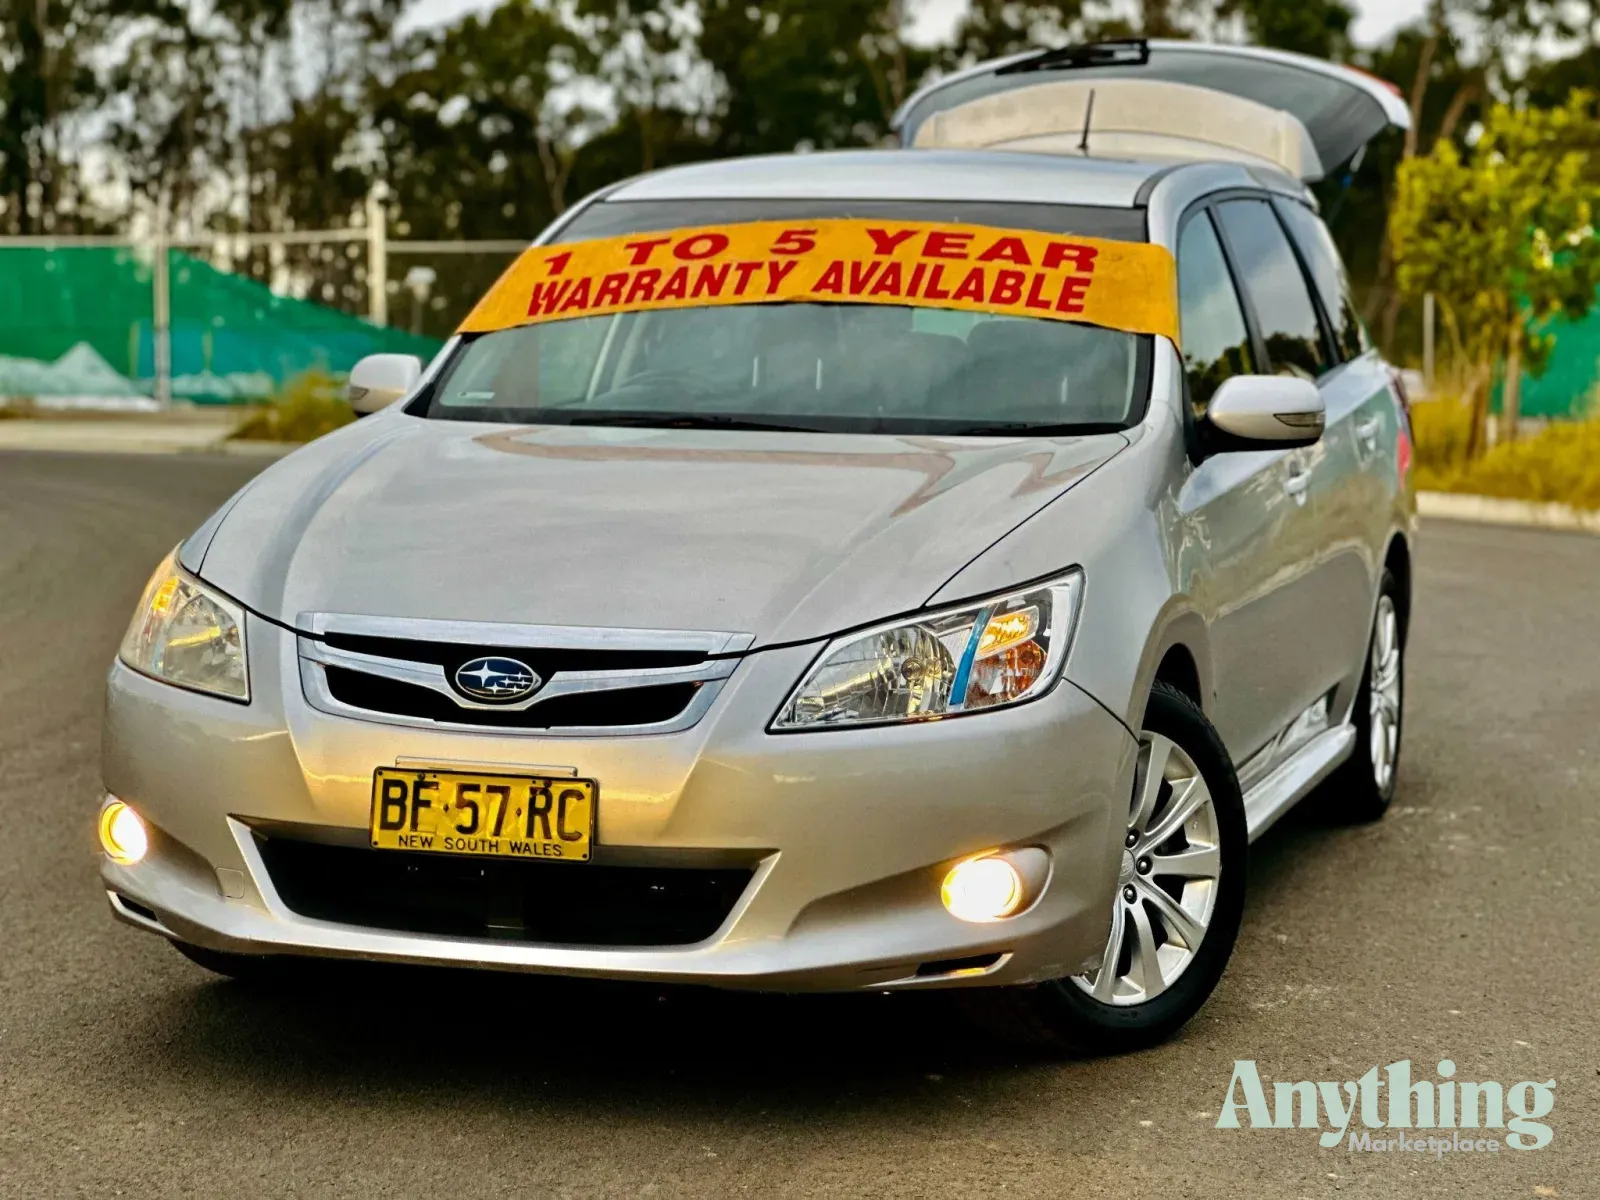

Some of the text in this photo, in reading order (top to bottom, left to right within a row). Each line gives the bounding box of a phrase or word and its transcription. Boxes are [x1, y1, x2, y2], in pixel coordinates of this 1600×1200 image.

[544, 228, 1099, 276] 1 TO 5 YEAR
[527, 260, 1092, 317] WARRANTY AVAILABLE
[454, 784, 511, 835] 57
[398, 835, 563, 856] NEW SOUTH WALES
